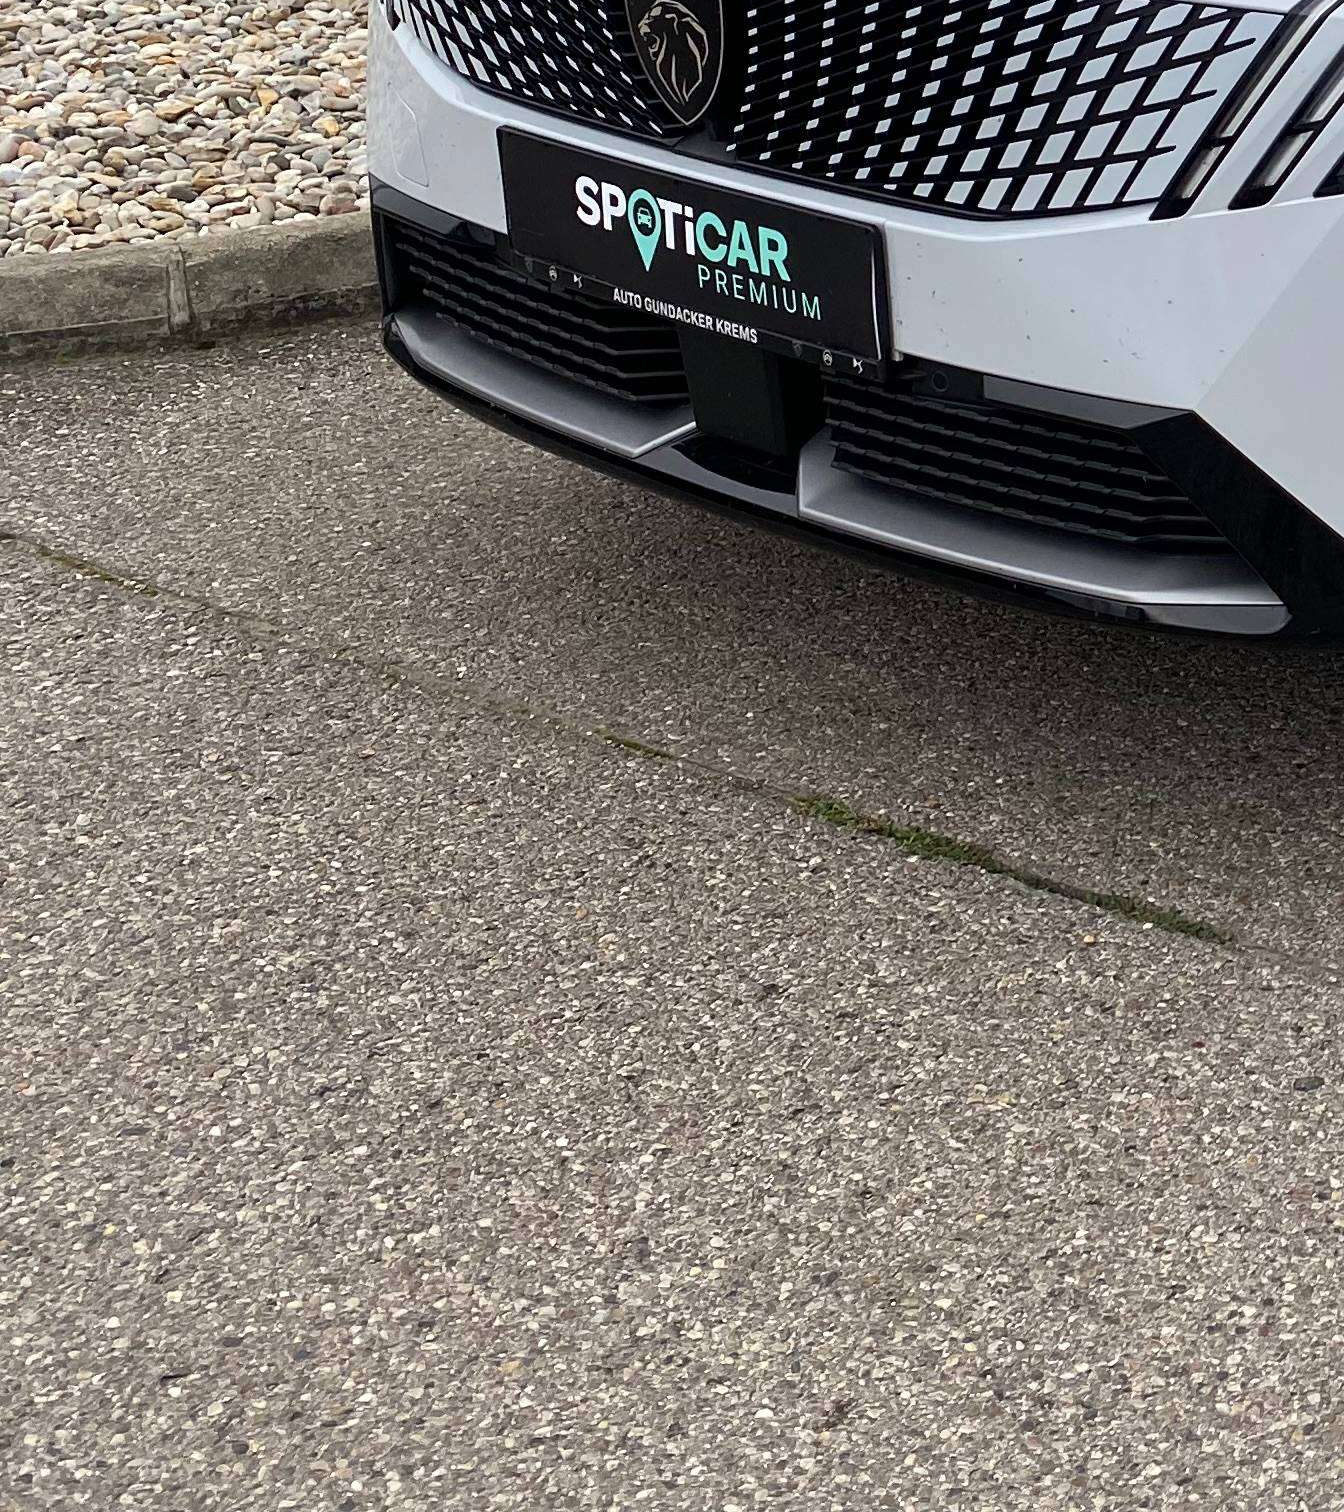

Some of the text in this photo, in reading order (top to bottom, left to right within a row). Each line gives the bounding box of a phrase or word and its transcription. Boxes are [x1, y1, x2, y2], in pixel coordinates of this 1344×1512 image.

[613, 287, 758, 344] AUTO GUNDACKER KREMS
[697, 264, 822, 321] PREMIUM
